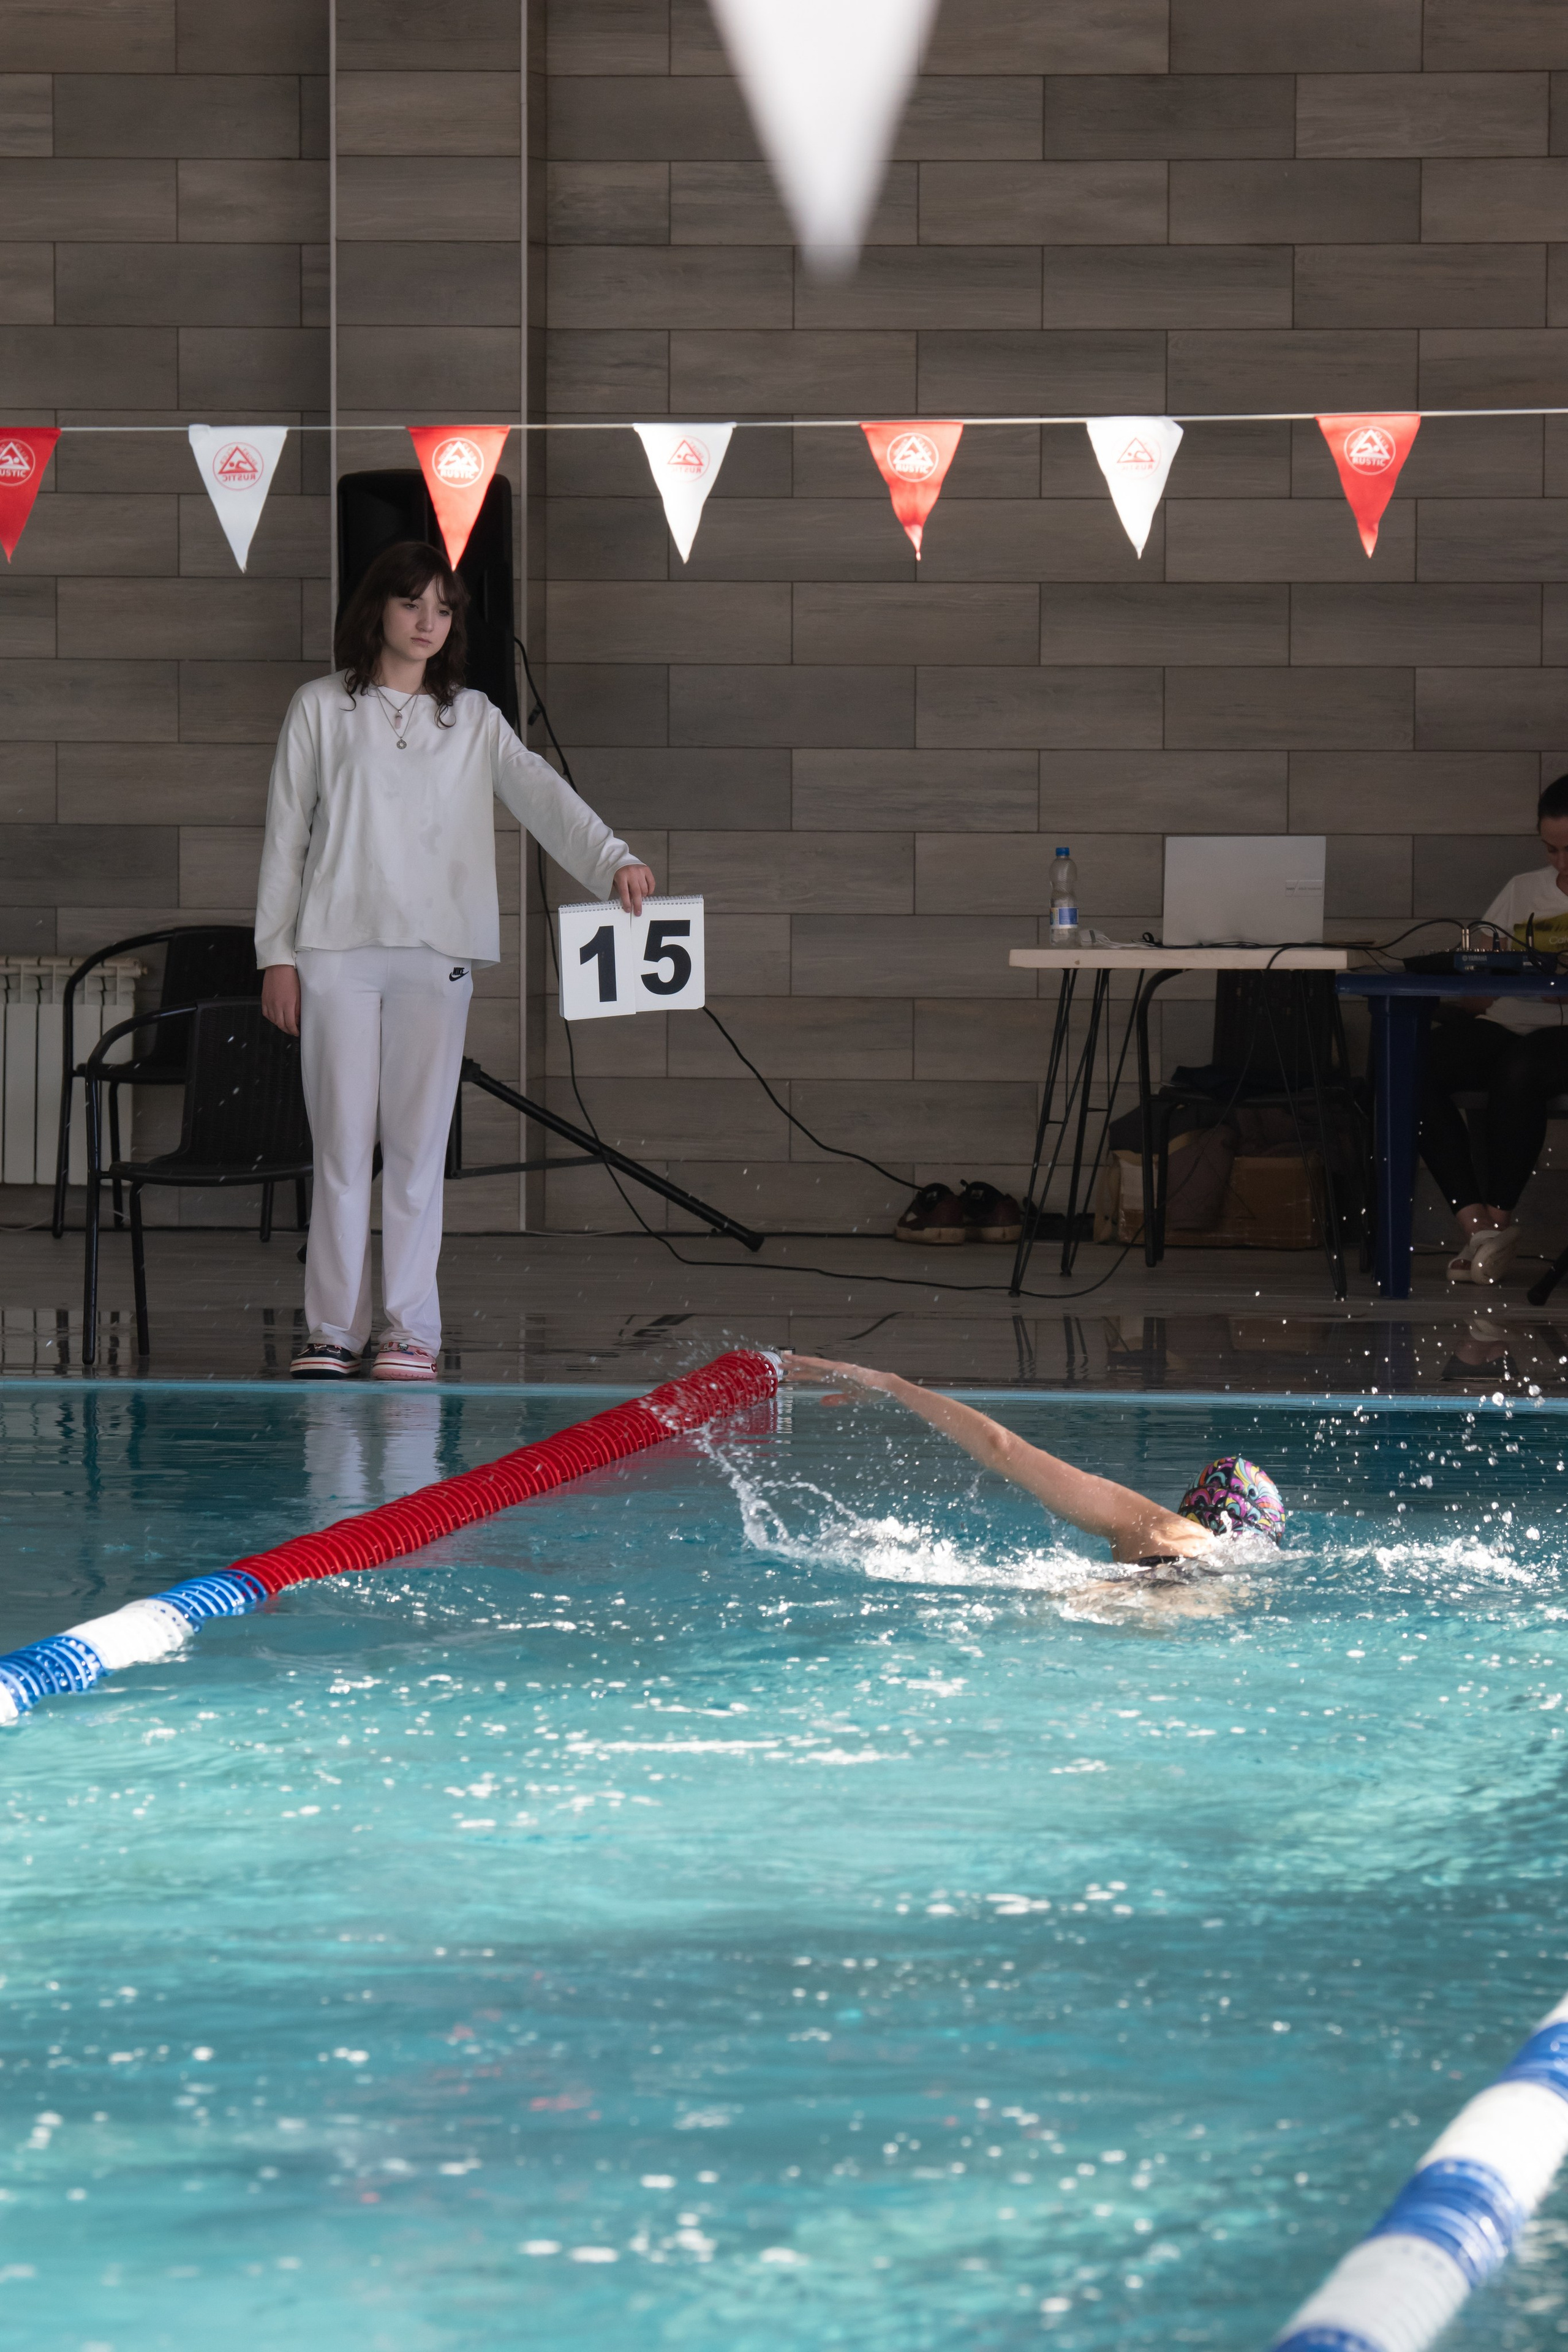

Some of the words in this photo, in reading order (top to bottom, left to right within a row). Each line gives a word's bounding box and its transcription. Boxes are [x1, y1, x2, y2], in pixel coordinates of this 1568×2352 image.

[1351, 457, 1386, 467] RUSTIC
[440, 469, 475, 479] RUSTIC
[895, 464, 929, 474] RUSTIC
[579, 919, 692, 1003] 15
[452, 967, 465, 976] NIKE
